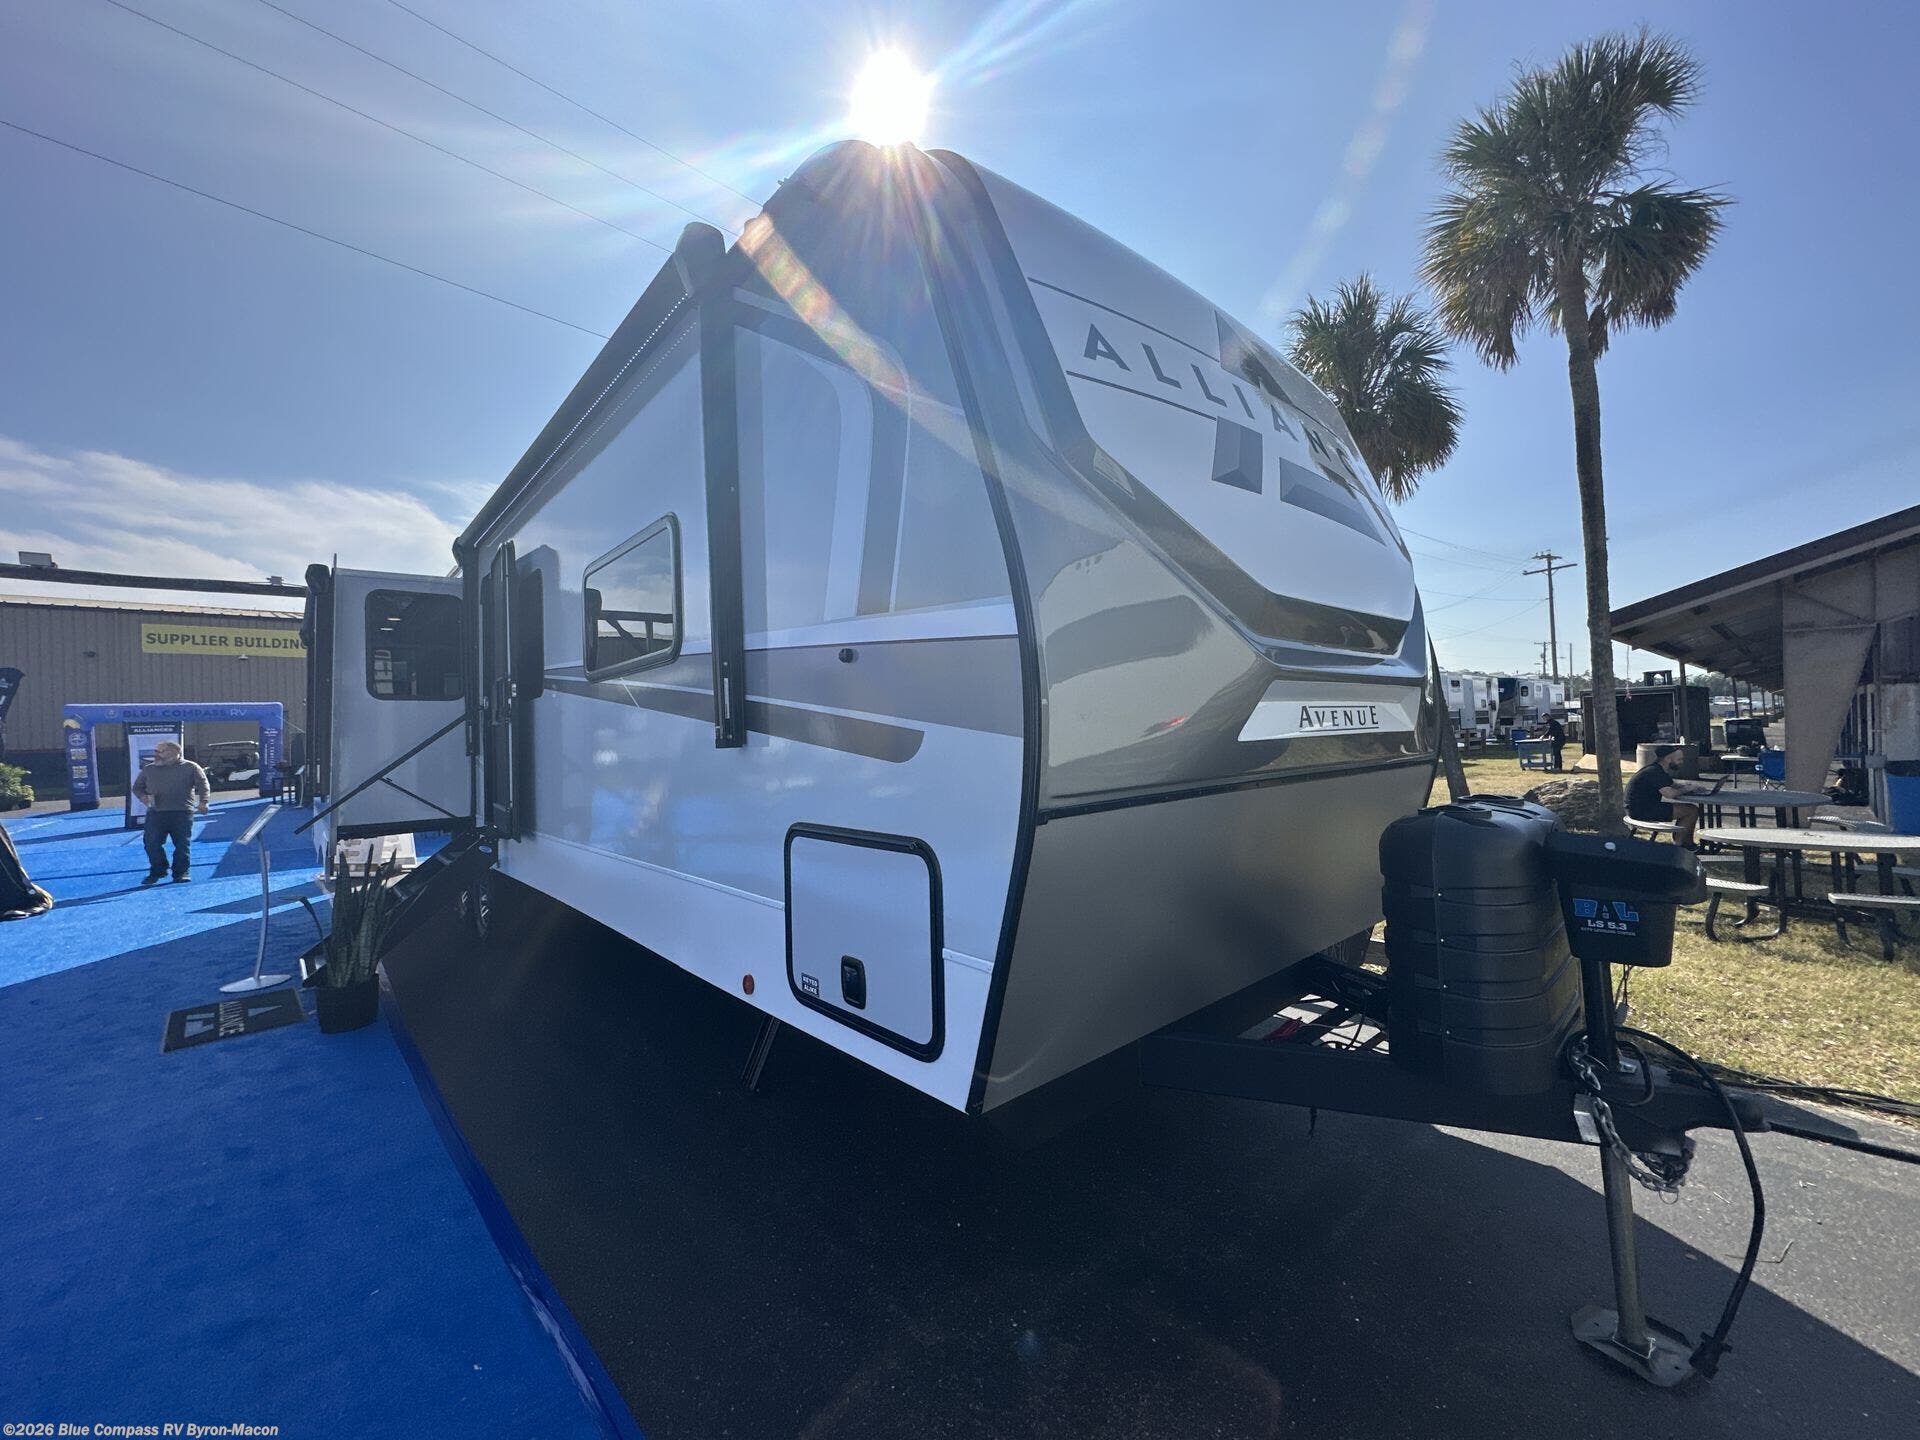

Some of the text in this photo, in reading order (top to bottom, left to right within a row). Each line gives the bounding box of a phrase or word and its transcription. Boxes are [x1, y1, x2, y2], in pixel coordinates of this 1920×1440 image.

[146, 632, 229, 647] SUPPLIER
[122, 708, 247, 718] BLUE COMPASS RV
[1587, 919, 1627, 931] LS 5.3
[803, 975, 818, 986] KEYED
